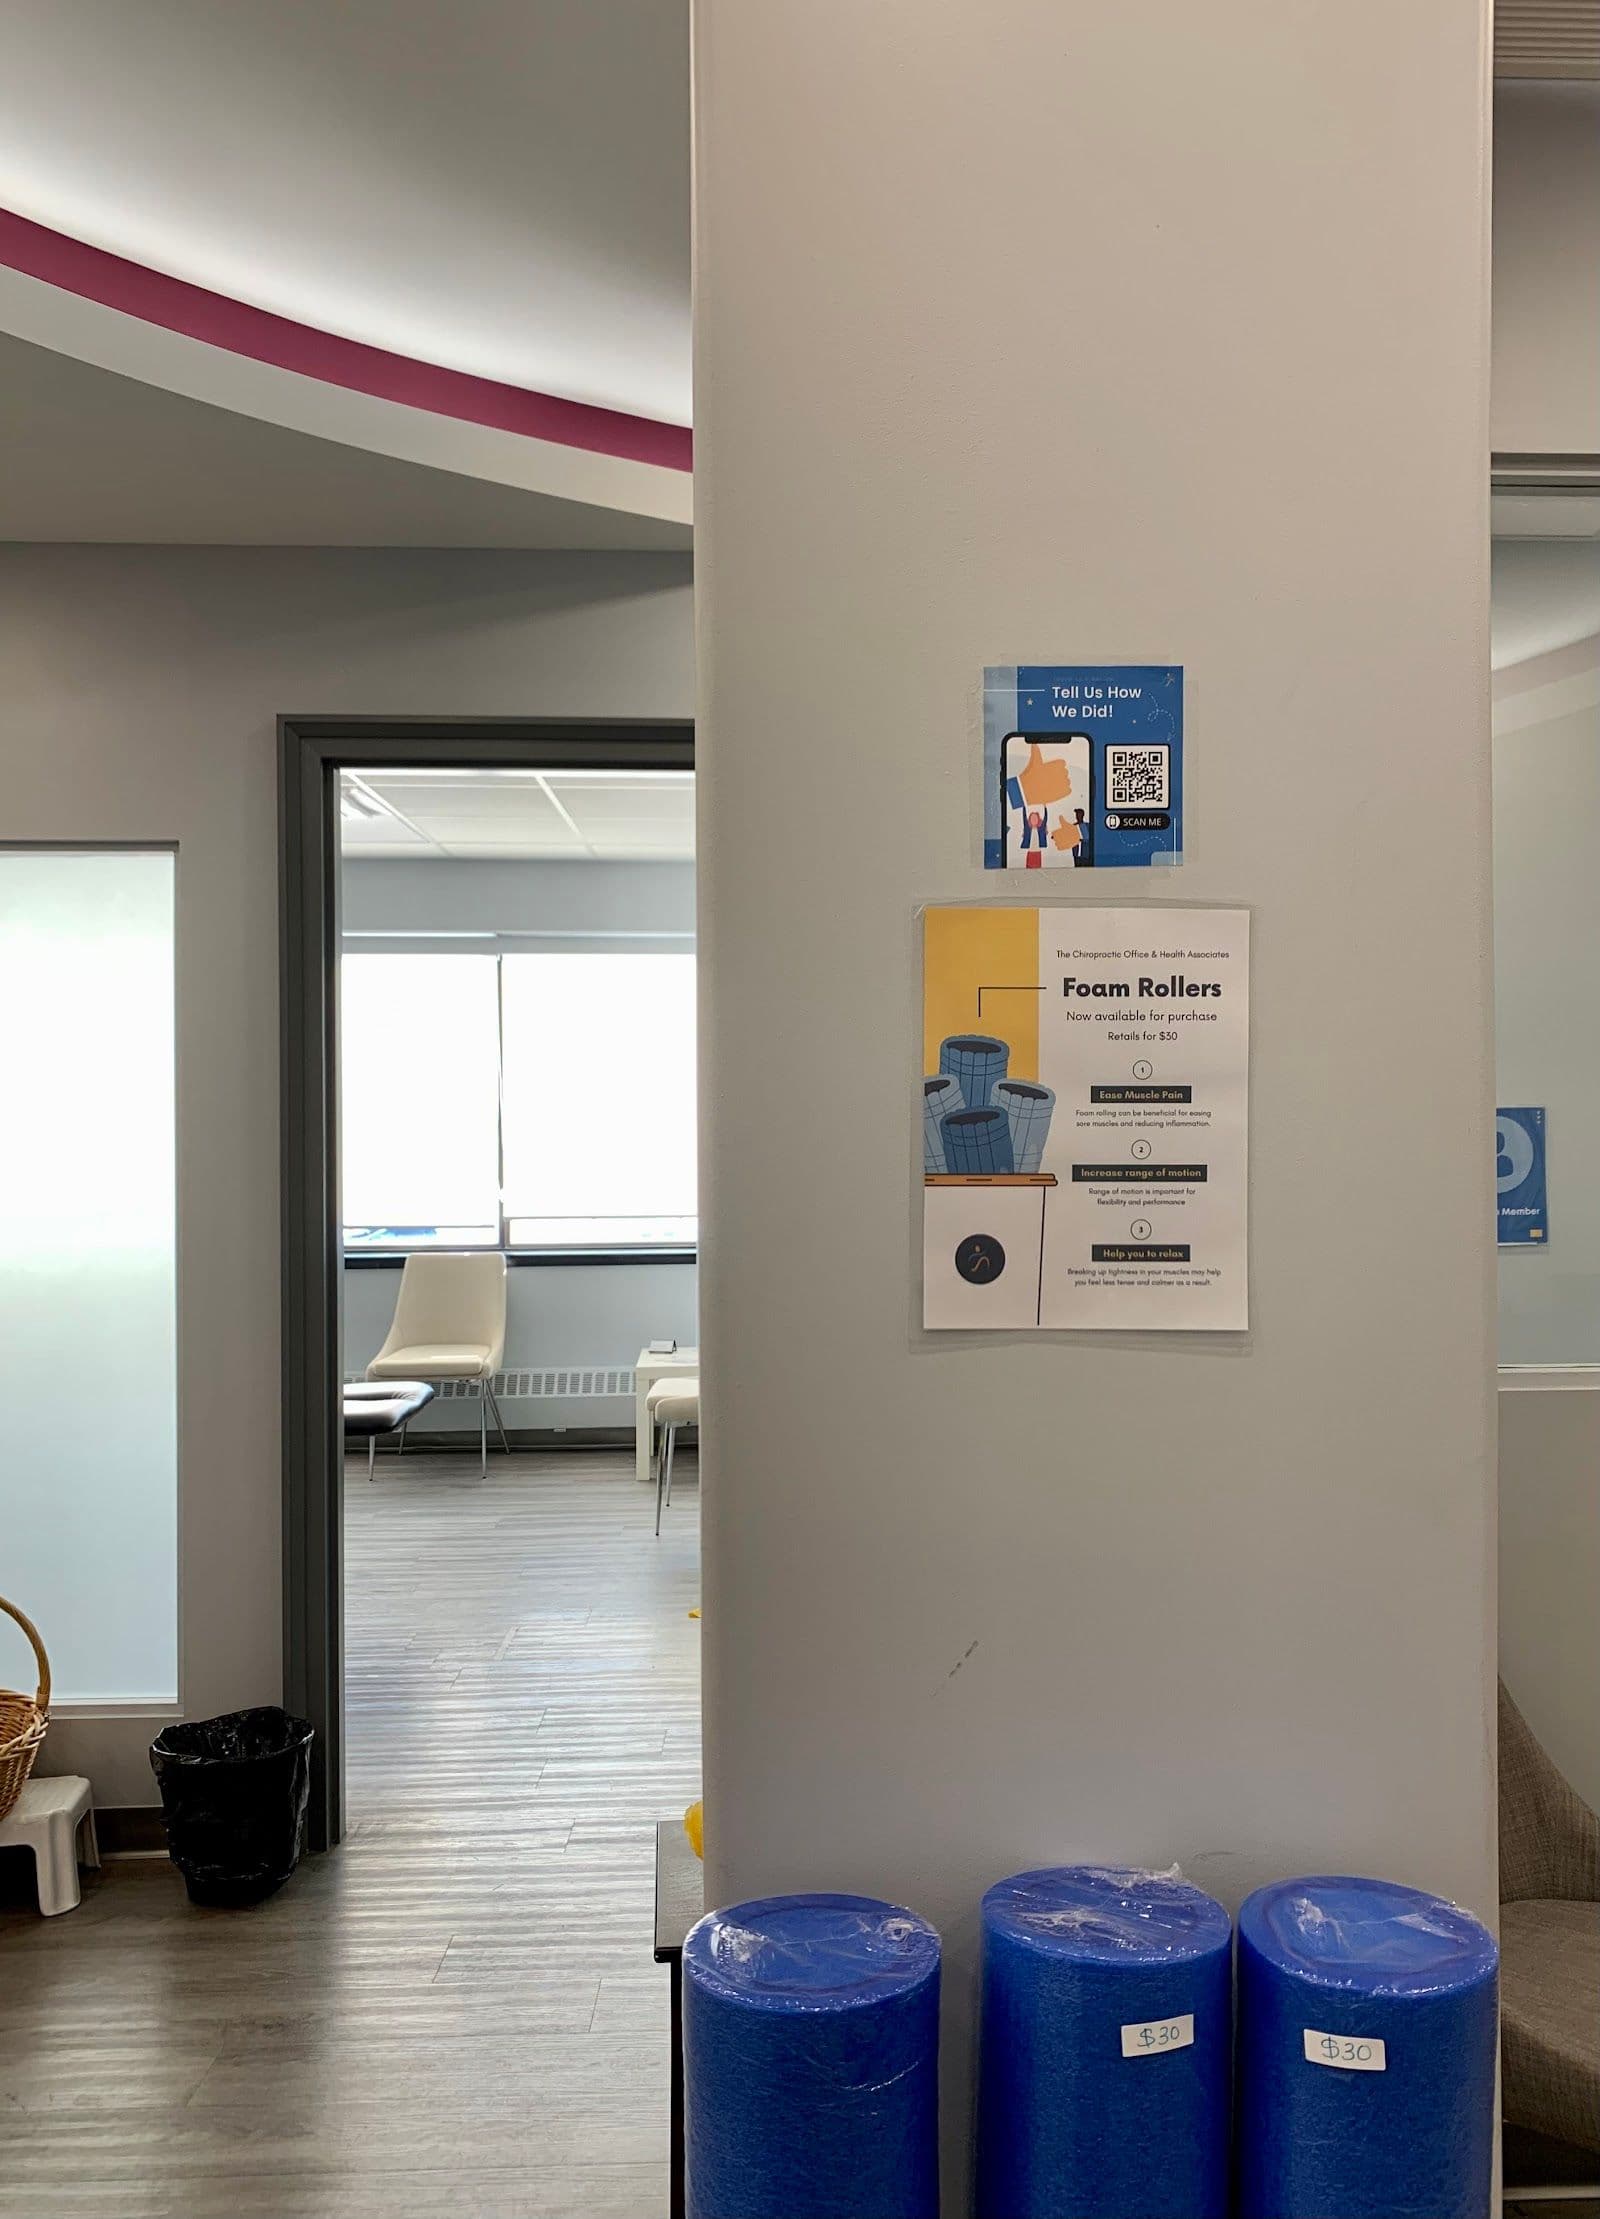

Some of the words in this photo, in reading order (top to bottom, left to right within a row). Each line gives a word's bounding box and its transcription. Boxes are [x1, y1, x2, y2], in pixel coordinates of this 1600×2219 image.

[1052, 686, 1079, 698] Tell
[1084, 686, 1103, 698] Us
[1107, 686, 1142, 698] How
[1052, 706, 1077, 718] We
[1082, 705, 1113, 718] Did!
[1123, 817, 1146, 826] SCAN
[1148, 817, 1162, 826] ME
[1056, 950, 1071, 958] The
[1072, 950, 1121, 960] Chiropractic
[1123, 950, 1149, 958] Office
[1160, 950, 1185, 958] Health
[1063, 977, 1129, 997] Foam
[1138, 975, 1222, 997] Rollers
[1066, 1011, 1092, 1021] Now
[1095, 1010, 1146, 1021] available
[1150, 1010, 1164, 1021] for
[1168, 1010, 1217, 1024] purchase
[1108, 1032, 1140, 1041] Retails
[1143, 1032, 1156, 1040] for
[1159, 1031, 1178, 1041] $30
[1099, 1090, 1123, 1099] Ease
[1125, 1090, 1160, 1099] Muscle
[1162, 1090, 1183, 1099] Pain
[1081, 1169, 1122, 1177] Increase
[1125, 1170, 1154, 1179] range
[1156, 1169, 1167, 1177] of
[1168, 1169, 1201, 1177] motion
[1097, 1198, 1126, 1206] flexibility
[1143, 1198, 1185, 1207] performance
[1103, 1249, 1124, 1260] Help
[1127, 1251, 1145, 1259] you
[1159, 1249, 1184, 1258] relax
[1067, 1268, 1096, 1276] Breaking
[1137, 2026, 1180, 2048] $30
[1320, 2036, 1372, 2061] $30
